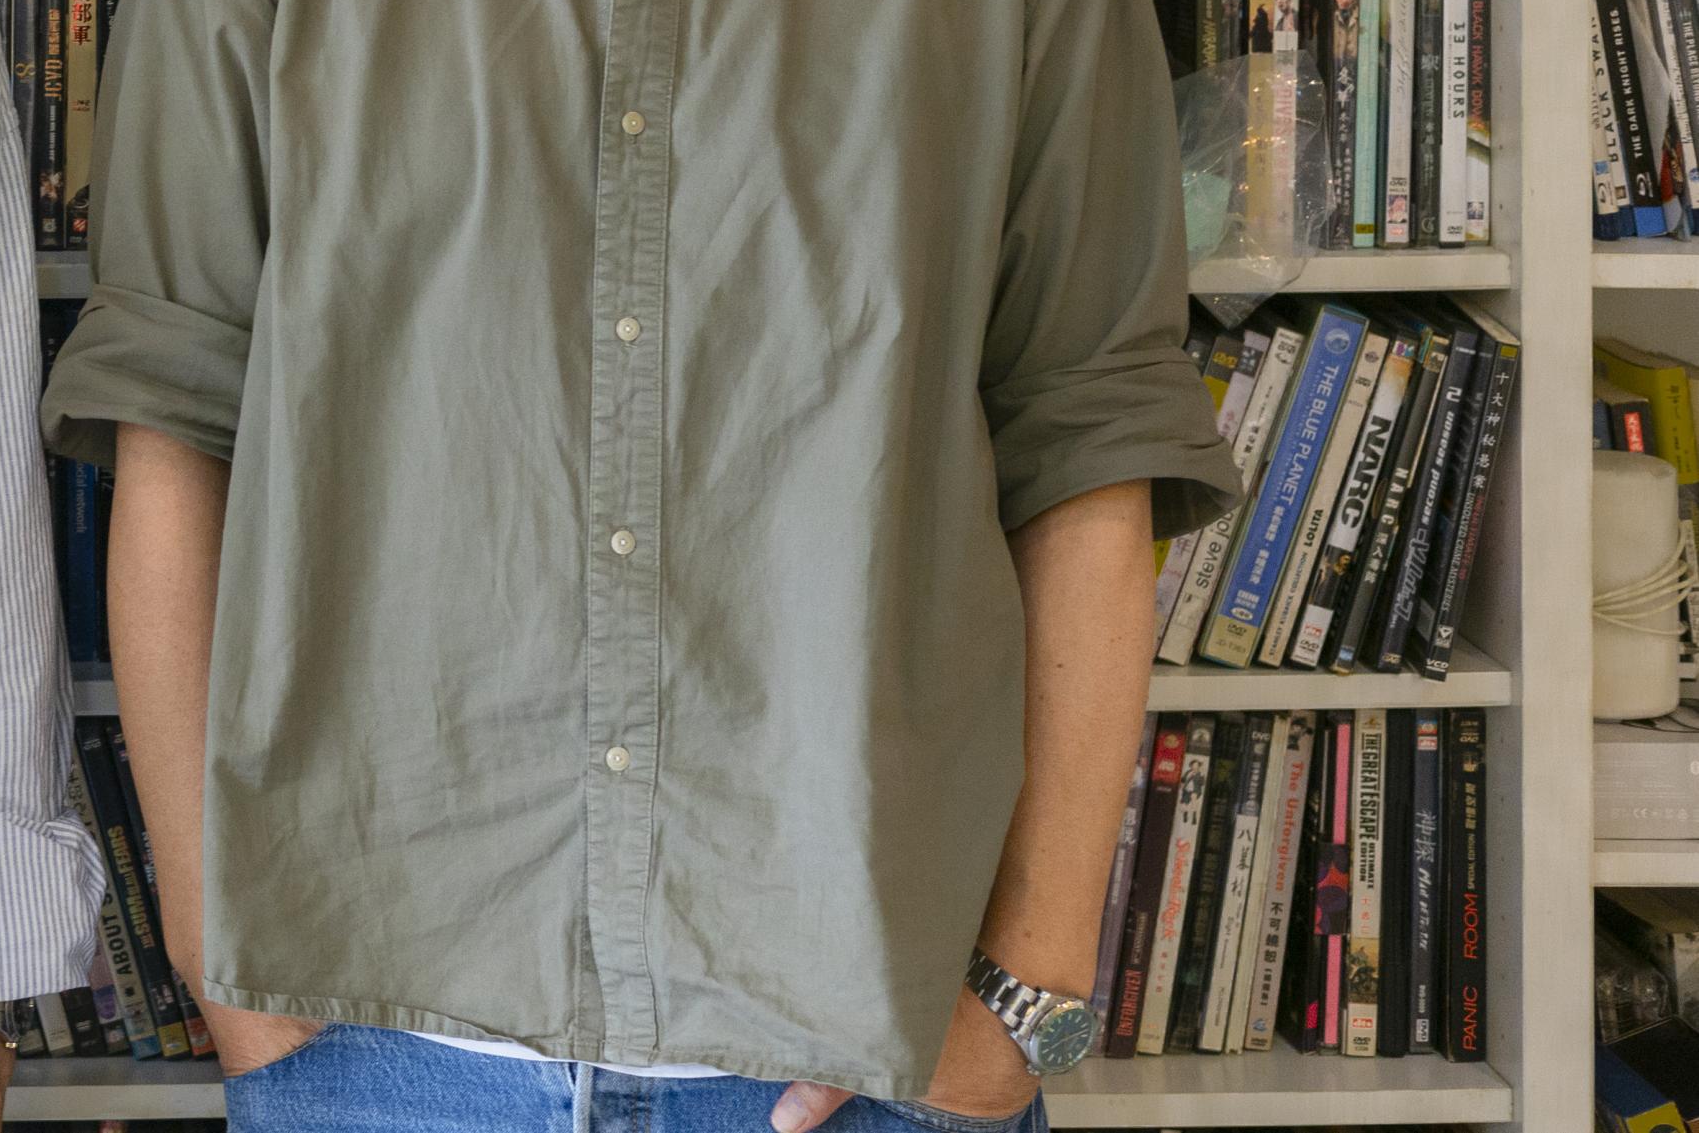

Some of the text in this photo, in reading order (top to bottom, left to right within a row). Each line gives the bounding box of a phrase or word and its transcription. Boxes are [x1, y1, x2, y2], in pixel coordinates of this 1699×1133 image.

[1452, 22, 1466, 120] 13 HOURS
[1471, 0, 1485, 130] BLACK HAWK DOWN
[1682, 21, 1697, 66] THE PLACE
[44, 58, 63, 101] JCVD
[1608, 8, 1644, 160] THE DARK KNIGHT RISES
[1602, 92, 1619, 164] BLACK
[1280, 365, 1340, 506] THE BLUE PLANET
[1421, 386, 1463, 526] second season 2
[1339, 414, 1392, 530] NARC
[1302, 506, 1325, 549] LOLITA
[1194, 540, 1224, 590] steve
[1425, 658, 1450, 669] VCD
[1290, 761, 1304, 791] The
[1360, 733, 1380, 840] THE GREAT ESCAPE
[105, 823, 135, 875] FEARS
[1275, 797, 1300, 893] Unforgiven
[1359, 842, 1376, 889] ULTIMATE EDITION
[100, 911, 134, 979] ABOUT
[125, 892, 151, 936] SUM
[1463, 892, 1480, 960] ROOM
[1116, 968, 1143, 1036] UNFORGIVEN
[1462, 984, 1479, 1052] PANIC
